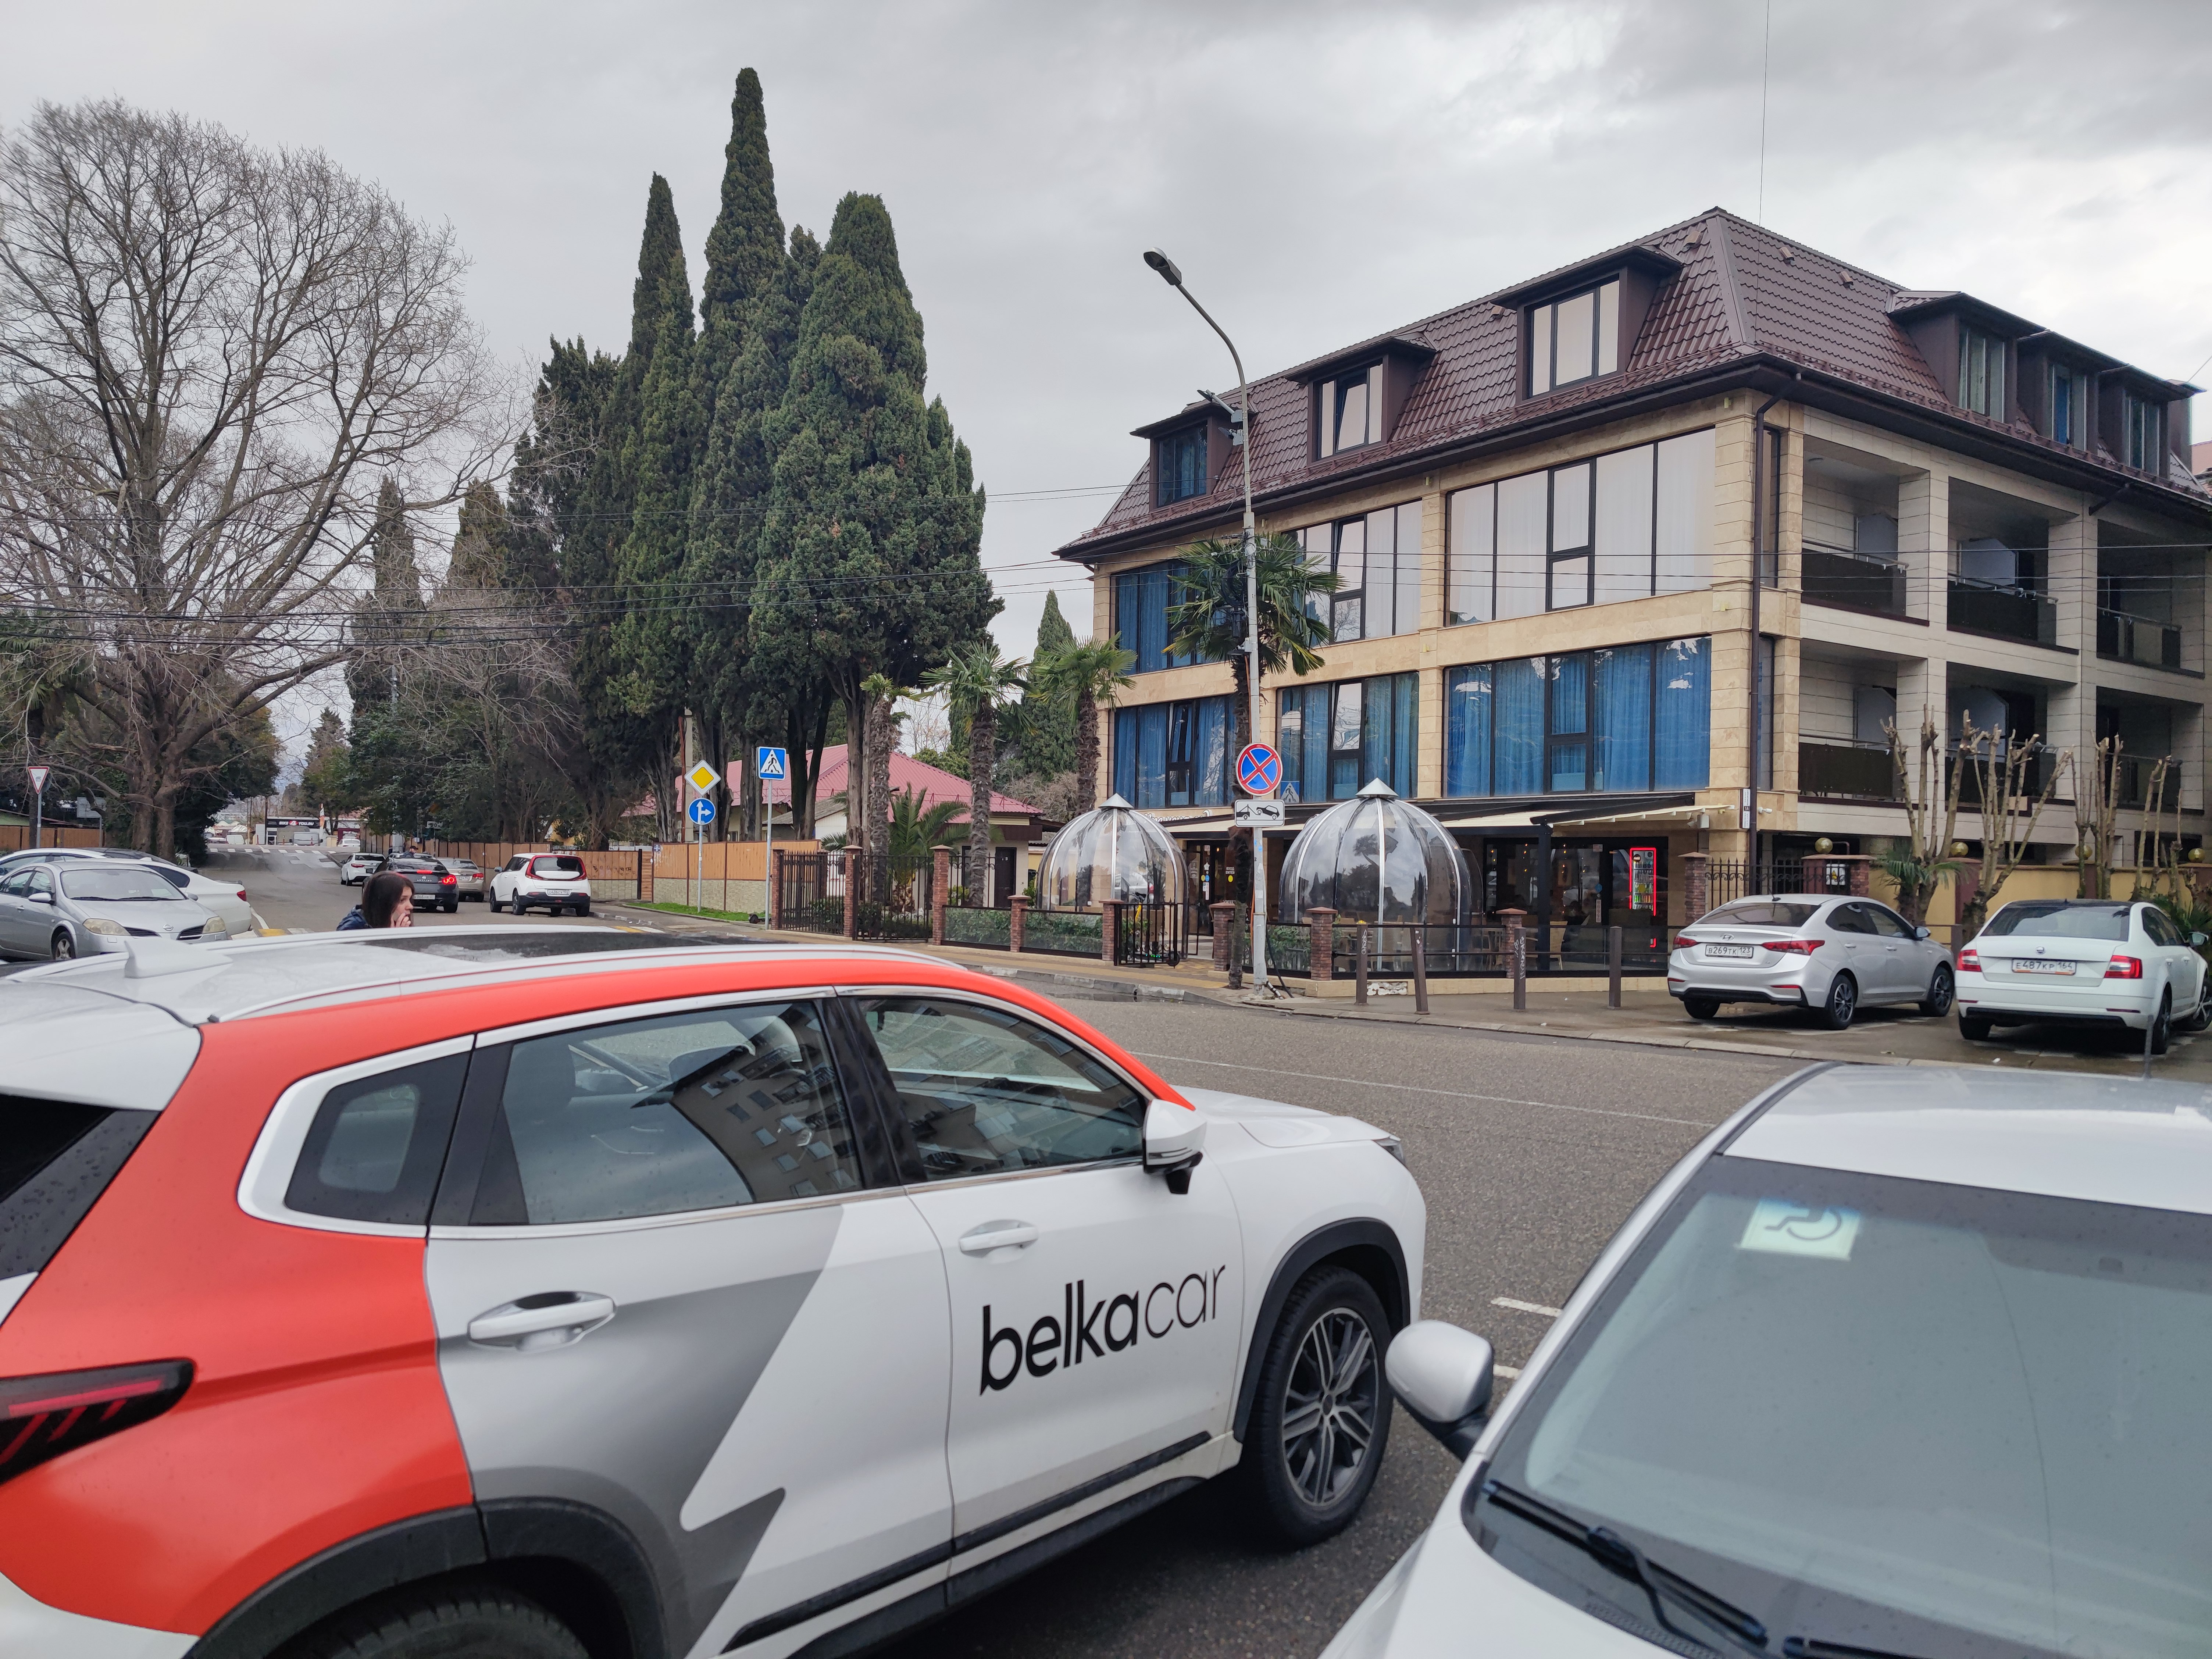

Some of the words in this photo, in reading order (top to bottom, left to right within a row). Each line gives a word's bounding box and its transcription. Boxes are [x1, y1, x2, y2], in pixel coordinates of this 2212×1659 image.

[1708, 946, 1737, 955] В269ТК
[2016, 960, 2055, 970] Е487КР
[980, 1264, 1226, 1396] belkacar
